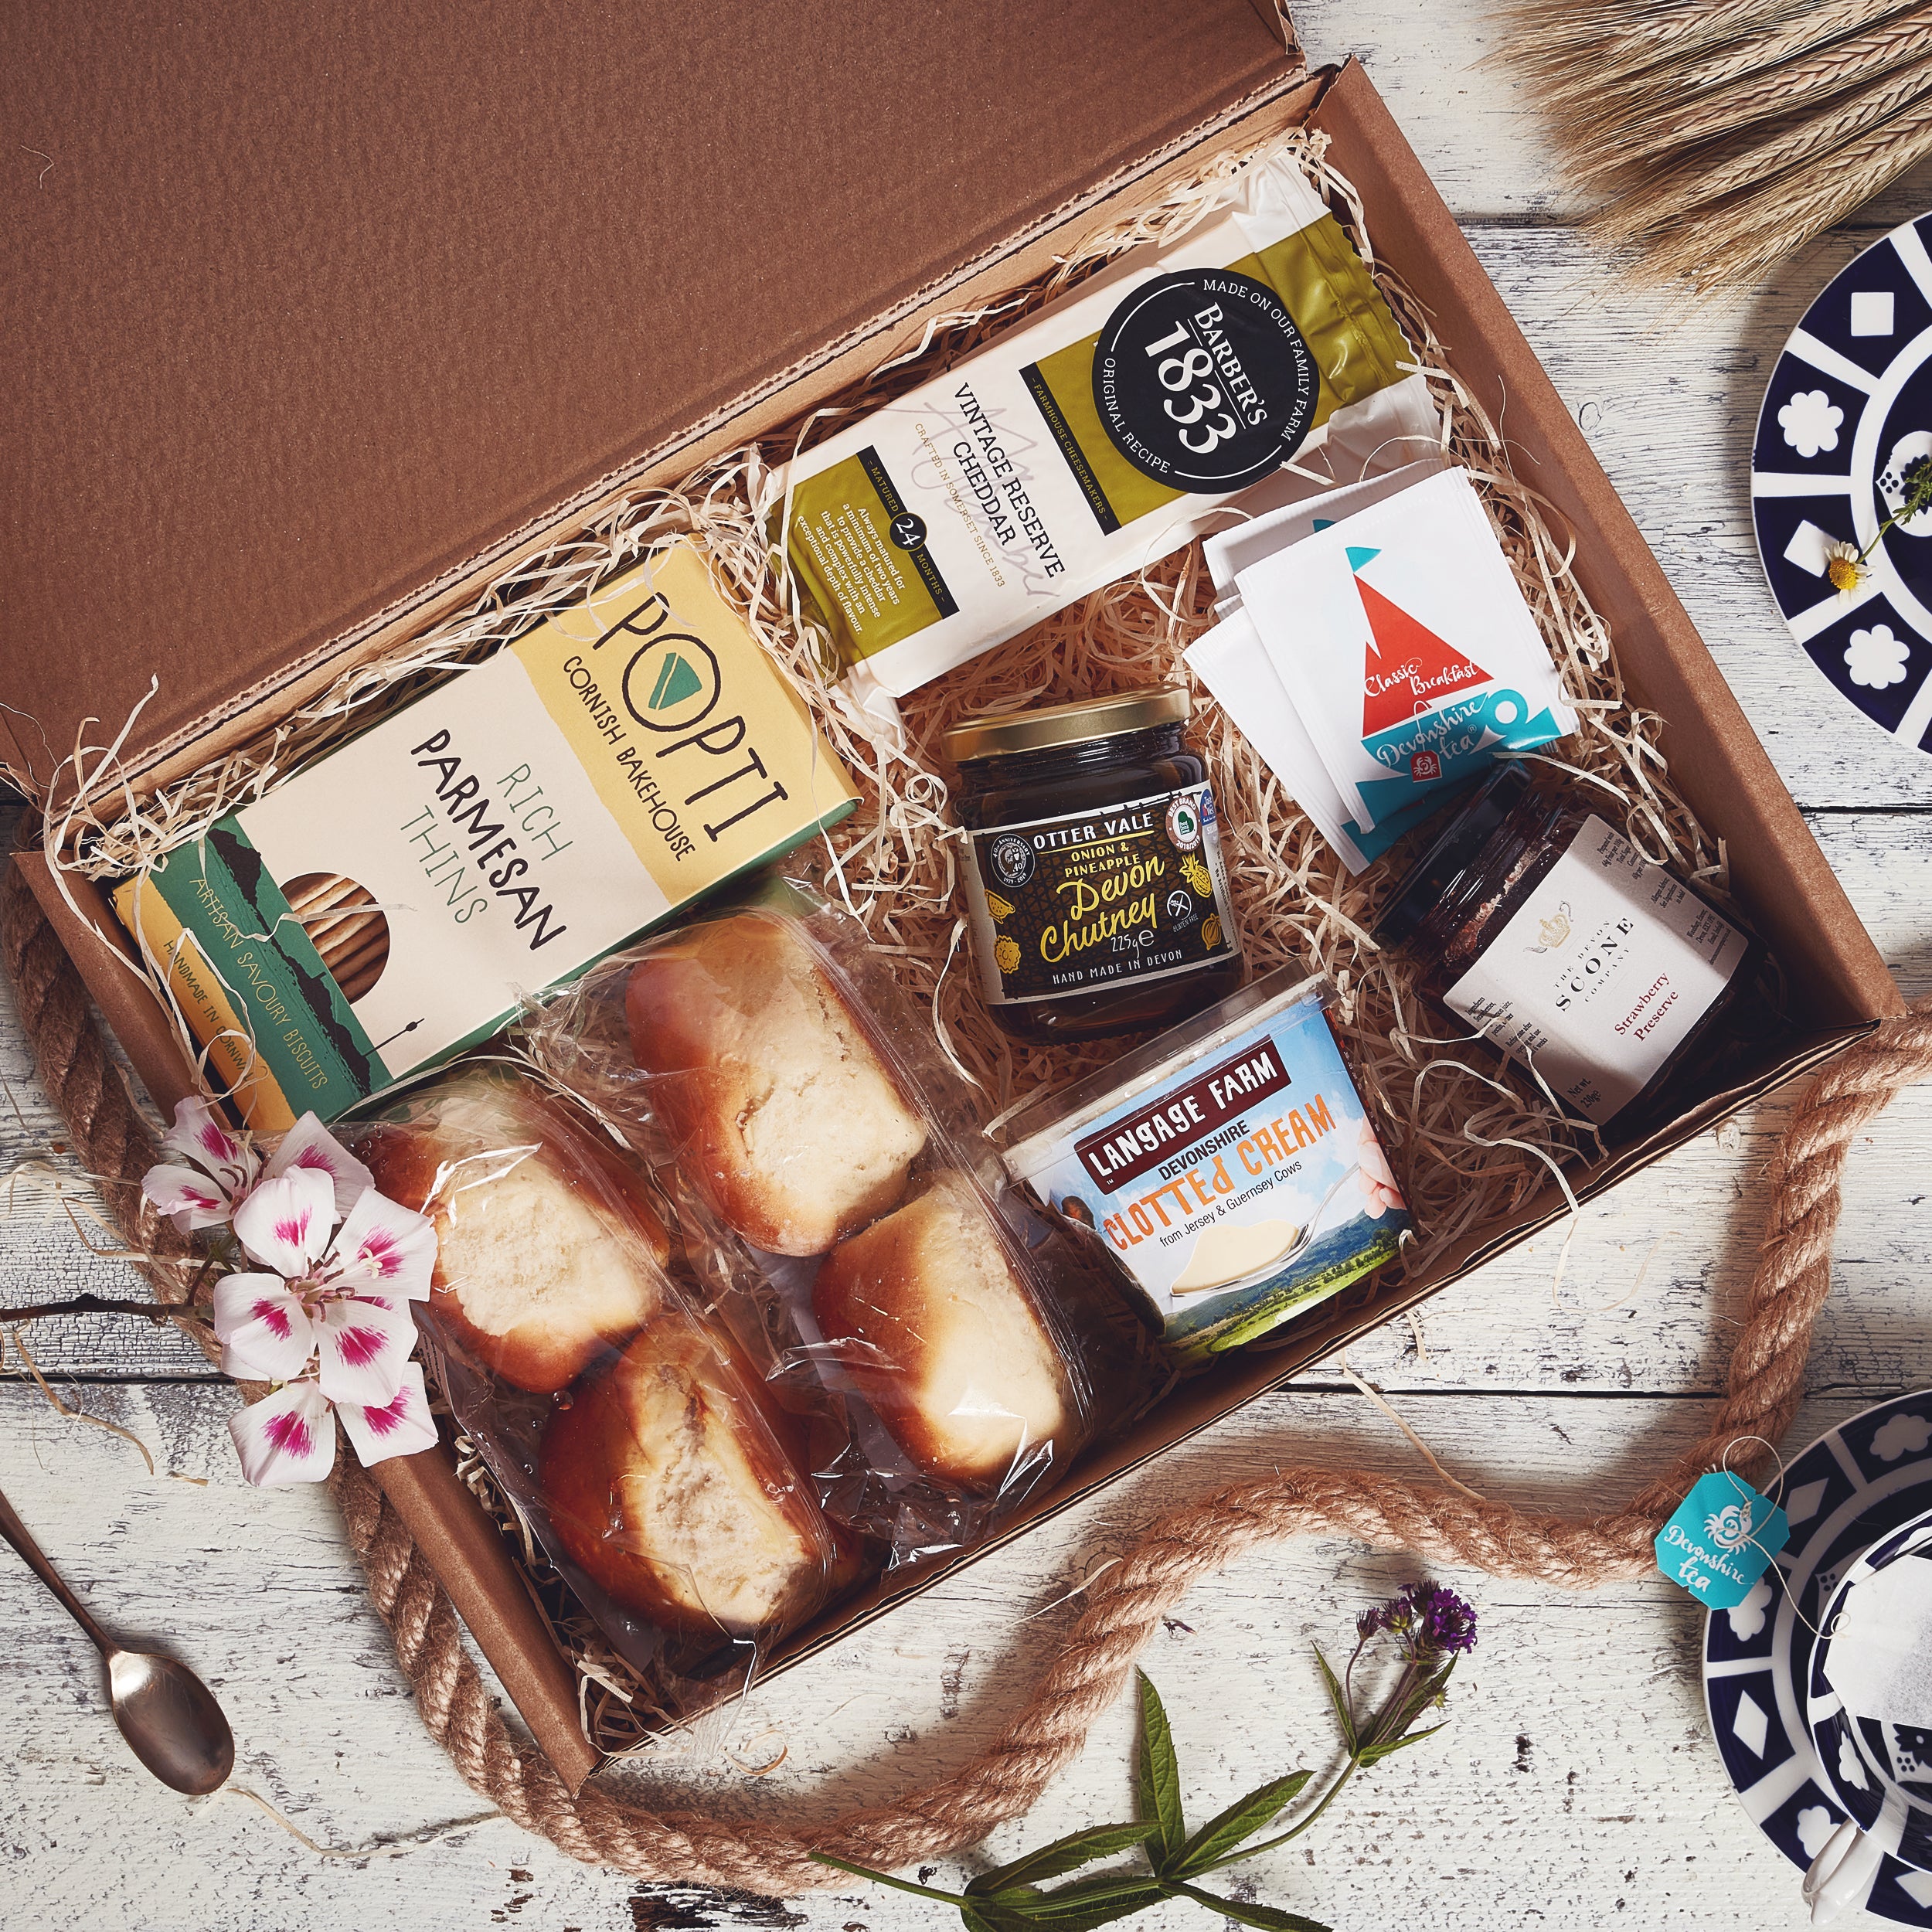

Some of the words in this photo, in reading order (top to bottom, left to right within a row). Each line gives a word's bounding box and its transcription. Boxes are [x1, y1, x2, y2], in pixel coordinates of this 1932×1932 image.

[1203, 279, 1248, 298] MADE
[1250, 292, 1272, 311] ON
[1270, 308, 1295, 338] OUR
[1145, 320, 1236, 454] 1833
[1289, 338, 1310, 396] FAMILY
[1103, 358, 1128, 433] ORIGINAL
[1122, 431, 1171, 474] RECIPE
[1281, 400, 1308, 442] FARM
[1034, 384, 1067, 440] FARMHOUSE
[1064, 441, 1106, 514] CHEESEMAKERS
[914, 423, 944, 468] CRAFTED
[938, 469, 950, 481] IN
[945, 482, 977, 534] SOMERSET
[974, 535, 993, 566] SINCE
[989, 566, 1005, 587] 1833
[954, 382, 1013, 478] VINTAGE
[1002, 477, 1065, 578] RESERVE
[954, 442, 1015, 546] CHEDDAR
[796, 515, 829, 566] exceptional
[821, 511, 835, 530] that
[831, 529, 839, 539] is
[837, 516, 845, 526] to
[840, 526, 862, 560] provide
[871, 467, 899, 512] MATURED
[896, 519, 920, 545] 24
[917, 553, 942, 594] MONTHS
[815, 526, 830, 543] and
[825, 544, 849, 581] complex
[845, 580, 859, 602] with
[855, 601, 865, 614] an
[834, 539, 864, 584] powerfully
[846, 510, 872, 553] minimum
[869, 553, 880, 563] of
[875, 563, 886, 580] two
[882, 580, 900, 604] years
[858, 509, 879, 539] Always
[875, 539, 899, 577] matured
[894, 576, 905, 590] for
[824, 566, 841, 592] depth
[838, 592, 848, 601] of
[859, 585, 880, 617] intense
[863, 566, 886, 602] cheddar
[842, 601, 862, 634] flavour.
[1364, 657, 1423, 697] Classic
[1408, 661, 1480, 696] Breakfast
[592, 591, 789, 842] POPTI
[1376, 691, 1488, 768] Devonshire
[563, 656, 627, 745] CORNISH
[616, 747, 696, 862] BAKEHOUSE
[496, 764, 573, 861] RICH
[1033, 825, 1097, 849] OTTER
[1104, 811, 1154, 835] VALE
[1168, 800, 1179, 818] BEST
[1179, 798, 1196, 811] BRAND
[400, 804, 488, 923] THINS
[410, 729, 566, 951] PARMESAN
[998, 837, 1030, 855] ANNIVERSARY
[1064, 853, 1141, 878] PINEAPPLE
[1070, 844, 1115, 862] ONION
[1120, 842, 1130, 852] &
[1175, 835, 1200, 850] 2018/2019
[1056, 855, 1165, 920] Devon
[1040, 893, 1158, 963] Chutney
[1554, 966, 1573, 988] THE
[1577, 920, 1610, 959] DEVON
[189, 878, 244, 949] ARTISAN
[236, 951, 292, 1026] SAVOURY
[283, 1029, 328, 1090] BISCUITS
[1053, 971, 1083, 985] HAND
[1090, 963, 1123, 978] MADE
[1128, 959, 1141, 971] IN
[1147, 949, 1182, 966] DEVON
[1556, 917, 1634, 1012] SCONE
[1584, 947, 1629, 1002] COMPANY
[202, 1006, 219, 1023] IN
[1614, 973, 1668, 1035] Strawberry
[1633, 992, 1678, 1042] Preserve
[1208, 1052, 1277, 1110] FARM
[1566, 1084, 1583, 1098] Net
[1579, 1078, 1591, 1087] wt.
[1158, 1120, 1250, 1181] DEVONSHIRE
[1239, 1094, 1336, 1175] CREAM
[1159, 1230, 1183, 1247] from
[1184, 1212, 1216, 1235] Jersey
[1216, 1205, 1226, 1217] &
[1226, 1178, 1274, 1209] Guernsey
[1274, 1162, 1301, 1182] Cows
[1664, 1525, 1754, 1585] Devonshire
[1678, 1556, 1711, 1593] tea
